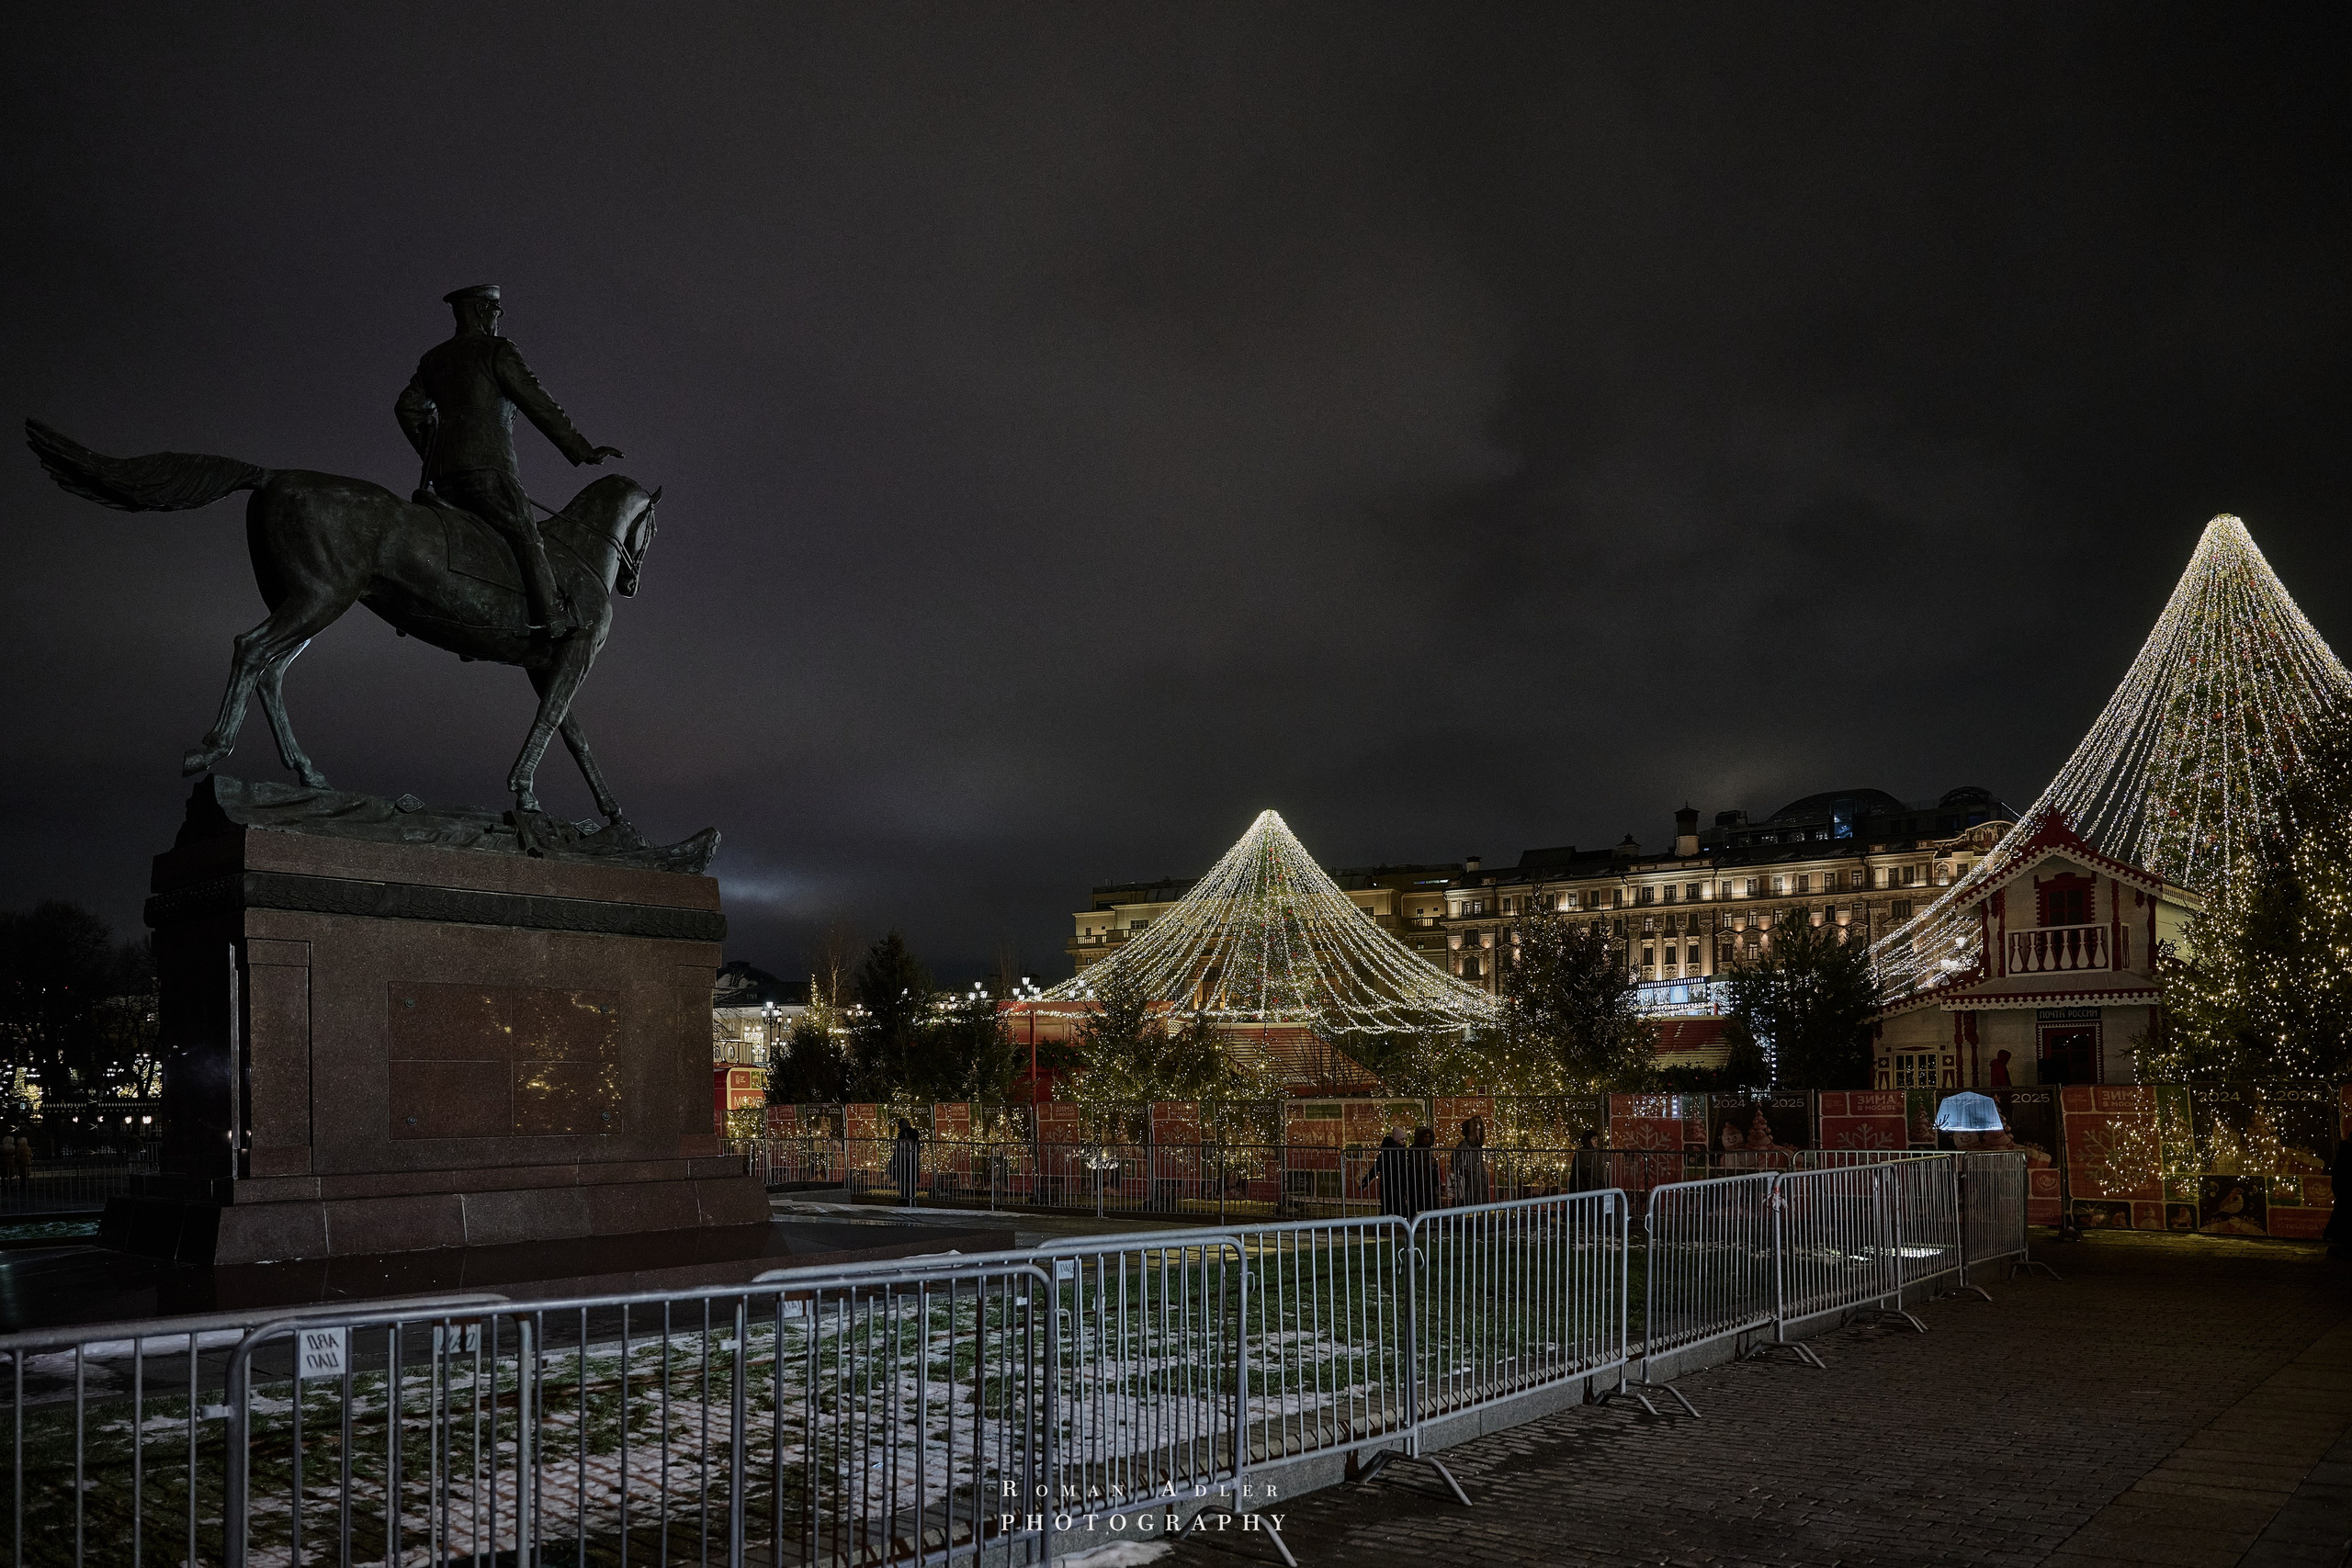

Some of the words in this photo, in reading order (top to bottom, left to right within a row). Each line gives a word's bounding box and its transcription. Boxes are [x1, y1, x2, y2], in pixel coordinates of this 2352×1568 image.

[2067, 1009, 2098, 1018] РОССИИ
[1857, 1095, 1897, 1105] ЗИМА
[2010, 1092, 2051, 1103] 2025
[2101, 1090, 2144, 1100] ЗИМА
[2198, 1091, 2241, 1102] 2024
[2276, 1089, 2323, 1101] 2025
[1569, 1101, 1597, 1111] 2025
[1713, 1099, 1746, 1109] 2024
[1771, 1098, 1805, 1108] 2025
[1255, 1105, 1275, 1113] 2025
